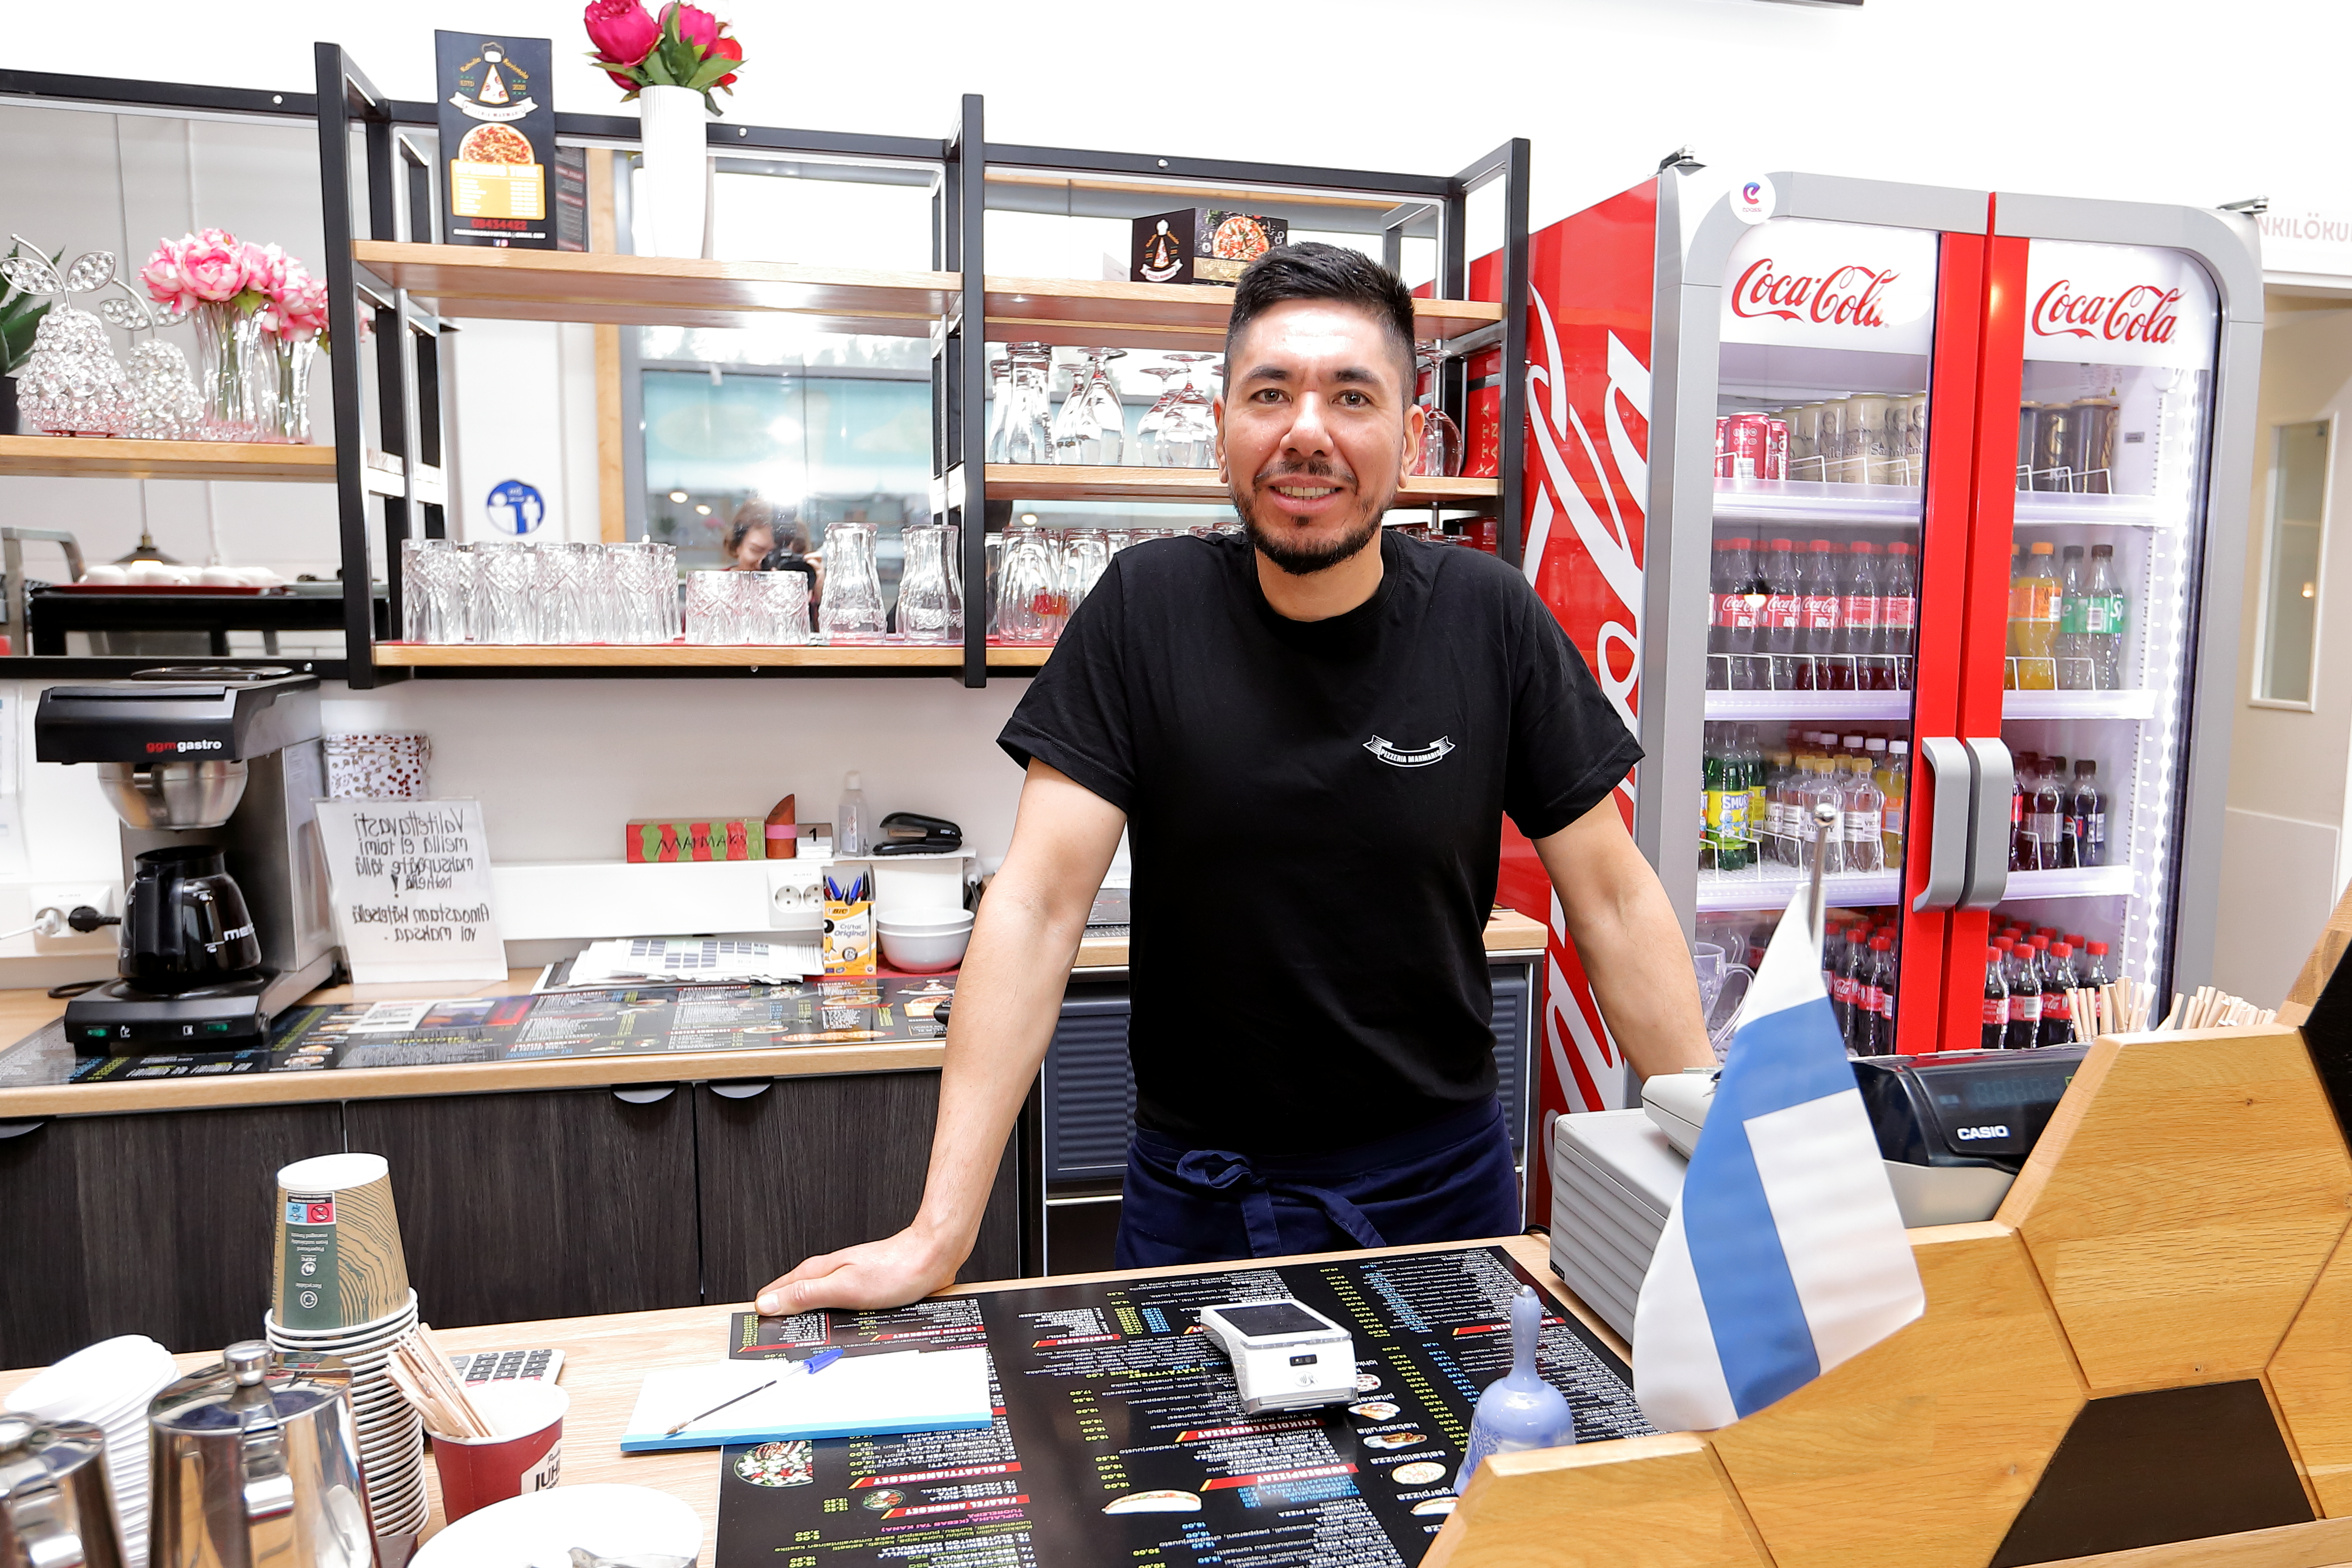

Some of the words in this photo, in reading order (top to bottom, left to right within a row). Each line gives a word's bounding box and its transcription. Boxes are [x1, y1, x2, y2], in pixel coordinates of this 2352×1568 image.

[1731, 258, 1901, 327] Coca-Cola
[2032, 280, 2187, 344] Coca-Cola
[1381, 749, 1407, 762] PIZZERIA
[1408, 750, 1441, 762] MARMARIS
[1722, 795, 1749, 810] SMUR
[834, 929, 867, 938] Original
[1957, 1125, 2010, 1140] CASIO
[892, 1329, 941, 1339] ANNOKSET
[1057, 1335, 1113, 1345] KASTIKKEET
[1356, 1422, 1419, 1435] kebabrulla
[907, 1434, 951, 1443] SALAATTI
[896, 1444, 942, 1453] SALAATTI
[878, 1454, 924, 1464] SALAATTI
[927, 1456, 1000, 1468] KANASALAATTI
[1369, 1450, 1446, 1464] salaattipizza
[873, 1464, 1006, 1484] SALAATTIANNOKSET
[1257, 1465, 1348, 1482] BURGERPIZZAT
[920, 1486, 956, 1494] SPECIAL
[957, 1481, 1000, 1491] FALAFEL
[1396, 1486, 1455, 1500] rgerpizza
[970, 1496, 1017, 1508] FALAFEL
[904, 1502, 966, 1515] ANNOKSET
[1277, 1509, 1305, 1517] PIZZA
[934, 1518, 969, 1526] (KEBAB
[971, 1512, 1024, 1522] TUPLALIHA
[897, 1529, 940, 1539] punasipuli
[877, 1546, 943, 1558] KEBABRULLA
[881, 1541, 942, 1553] KANARULLA
